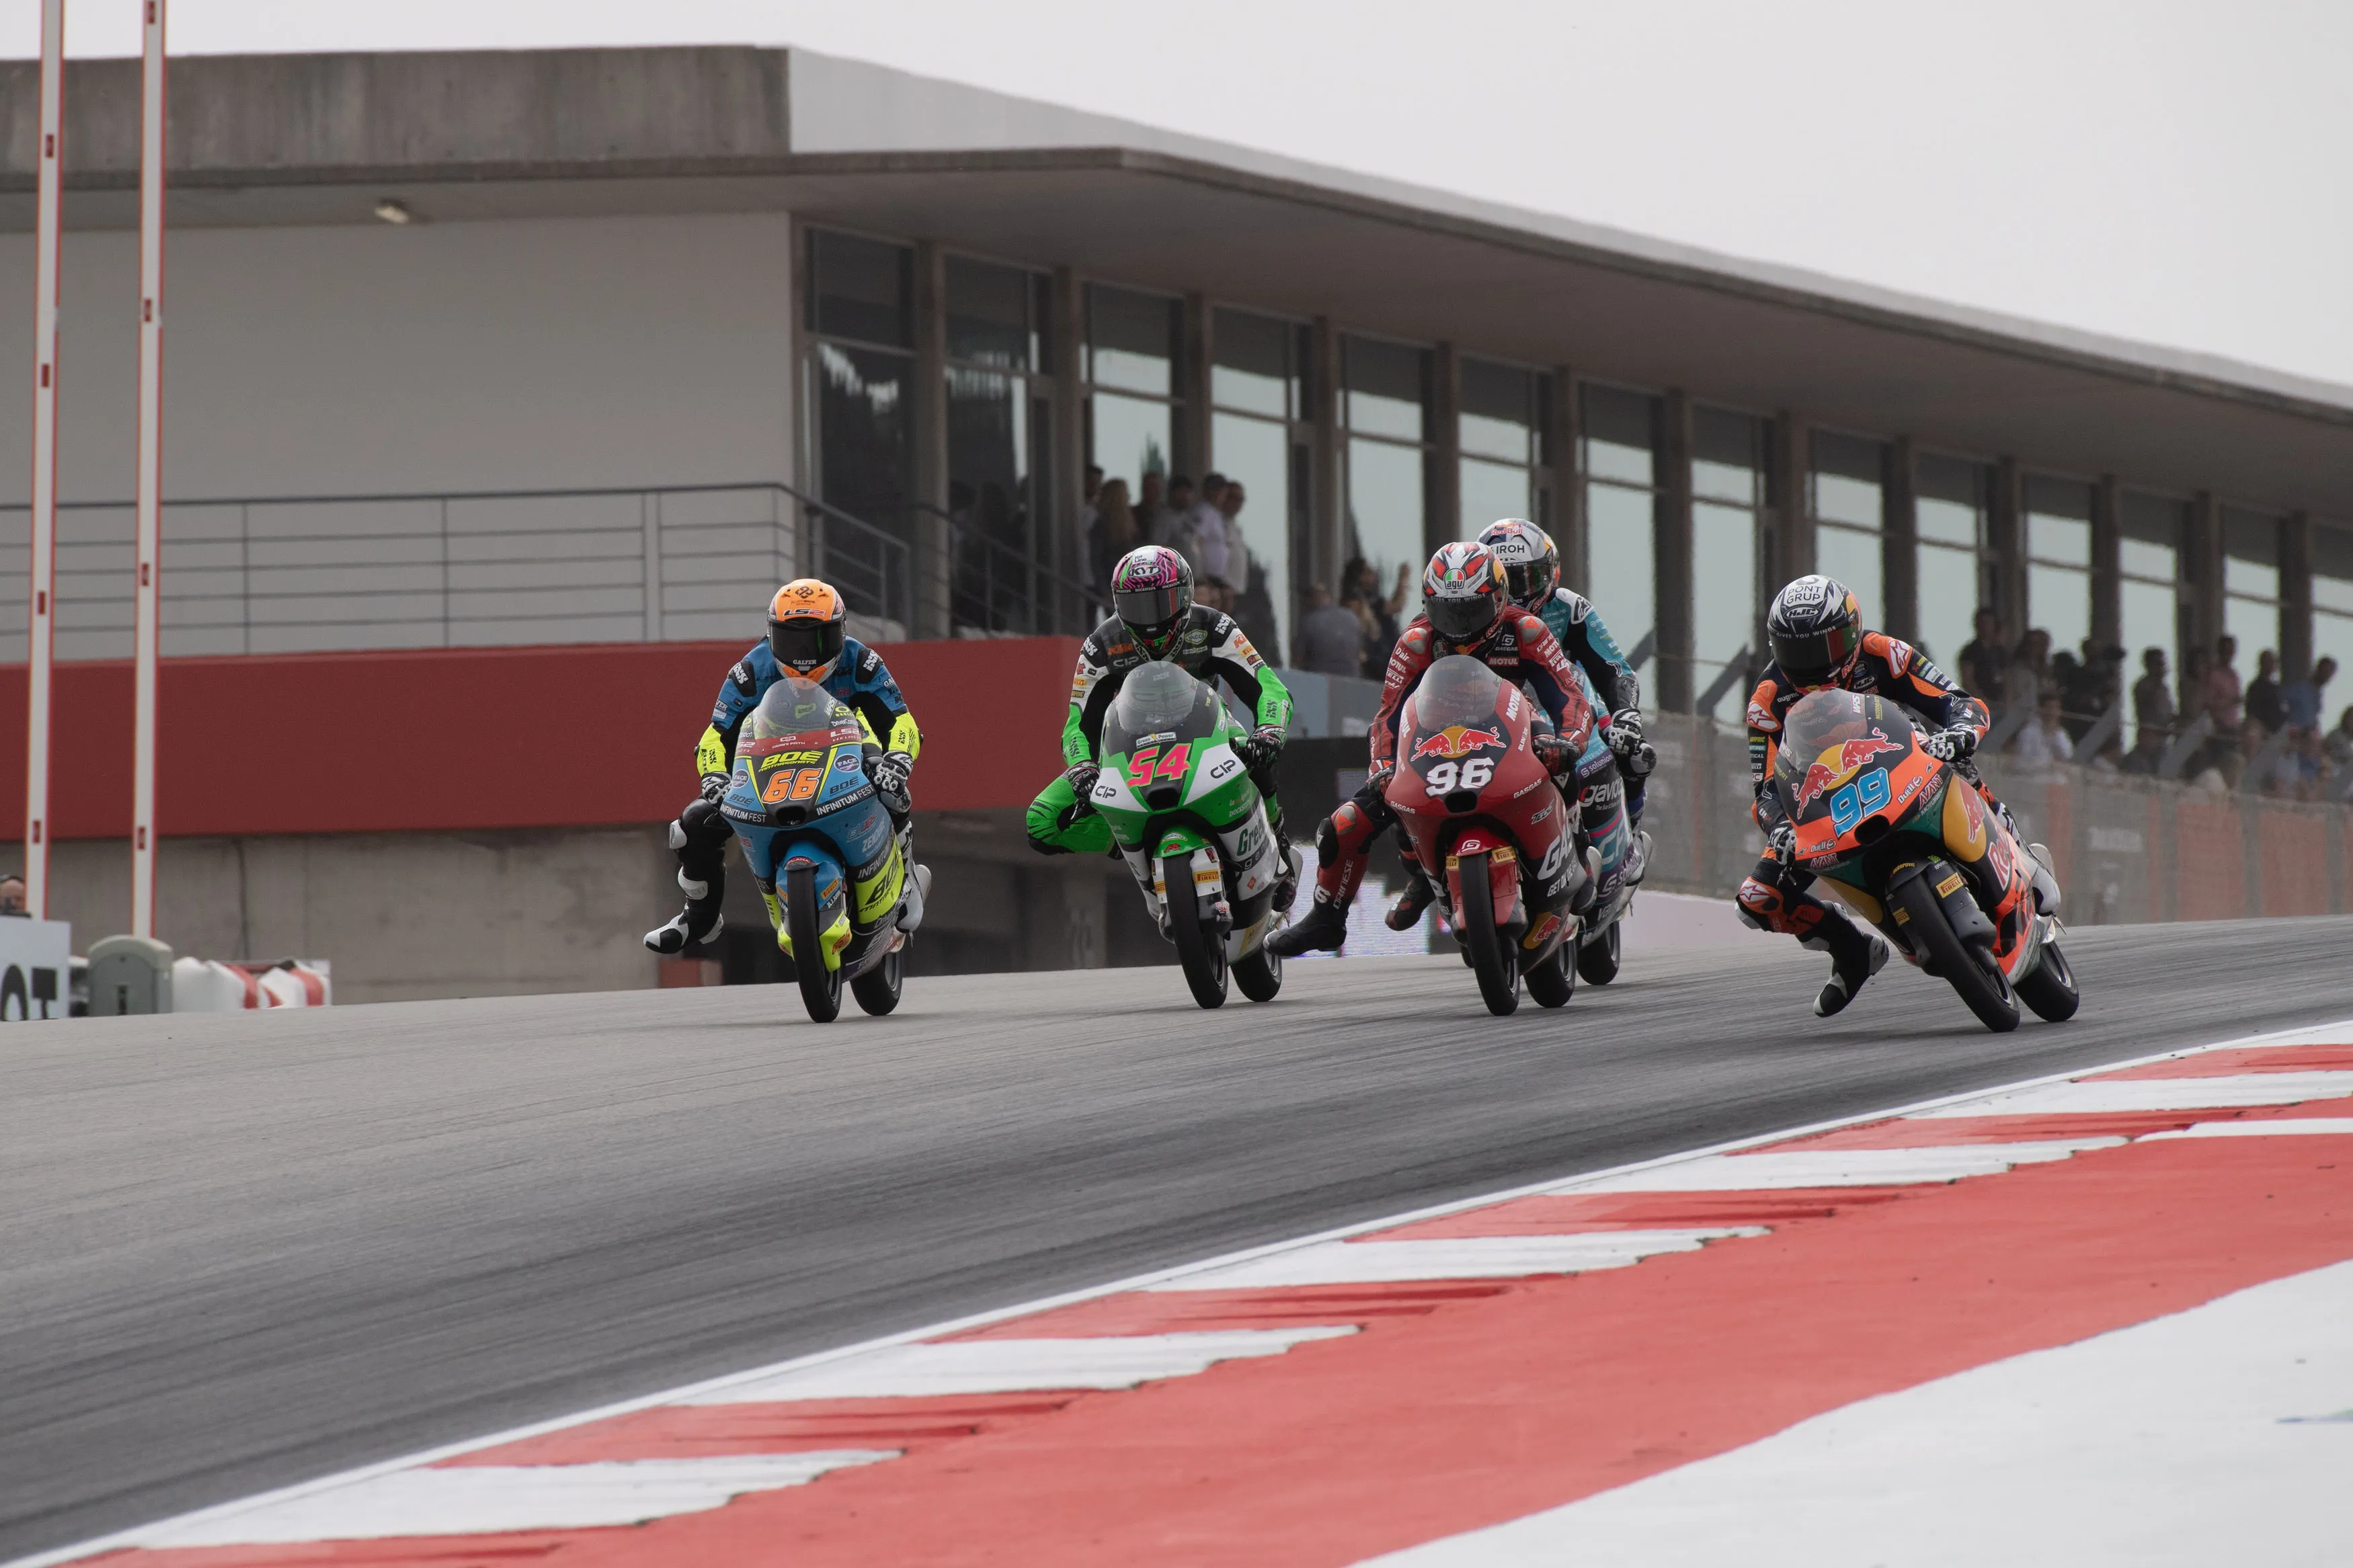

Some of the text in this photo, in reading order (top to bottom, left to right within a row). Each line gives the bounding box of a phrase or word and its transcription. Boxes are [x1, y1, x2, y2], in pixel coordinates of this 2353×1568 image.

[1491, 526, 1523, 536] Red Bull
[1492, 544, 1525, 554] IROH
[1131, 567, 1158, 576] KYT
[1447, 580, 1463, 589] agv
[1788, 585, 1823, 596] PONT
[1464, 593, 1486, 602] WINGS
[1787, 593, 1821, 604] GRUP
[783, 608, 826, 617] LS2
[1788, 609, 1817, 618] HJC
[1812, 626, 1837, 636] WINGS
[1113, 656, 1139, 667] CIP
[826, 695, 838, 716] WRS
[1505, 688, 1521, 722] MOTUL
[1851, 694, 1862, 714] WRS
[830, 727, 860, 737] LS2
[836, 757, 857, 767] FACE
[1125, 743, 1191, 788] 54
[1210, 759, 1236, 779] CIP
[1588, 754, 1613, 772] solunion
[1425, 757, 1494, 796] 96
[762, 768, 824, 804] 66
[1094, 786, 1117, 798] CIP
[1513, 778, 1542, 799] GASGAS
[1919, 774, 1944, 808] AVANT
[816, 792, 859, 816] INFINITUM
[857, 784, 875, 798] FEST
[1390, 800, 1416, 814] GASGAS
[1830, 767, 1892, 838] 99
[719, 804, 767, 823] INFINITUM FEST
[1810, 852, 1840, 869] AVANT
[1197, 871, 1219, 882] PIRELLI
[1332, 859, 1354, 909] DAINESE
[1940, 876, 1962, 895] PIRELLI
